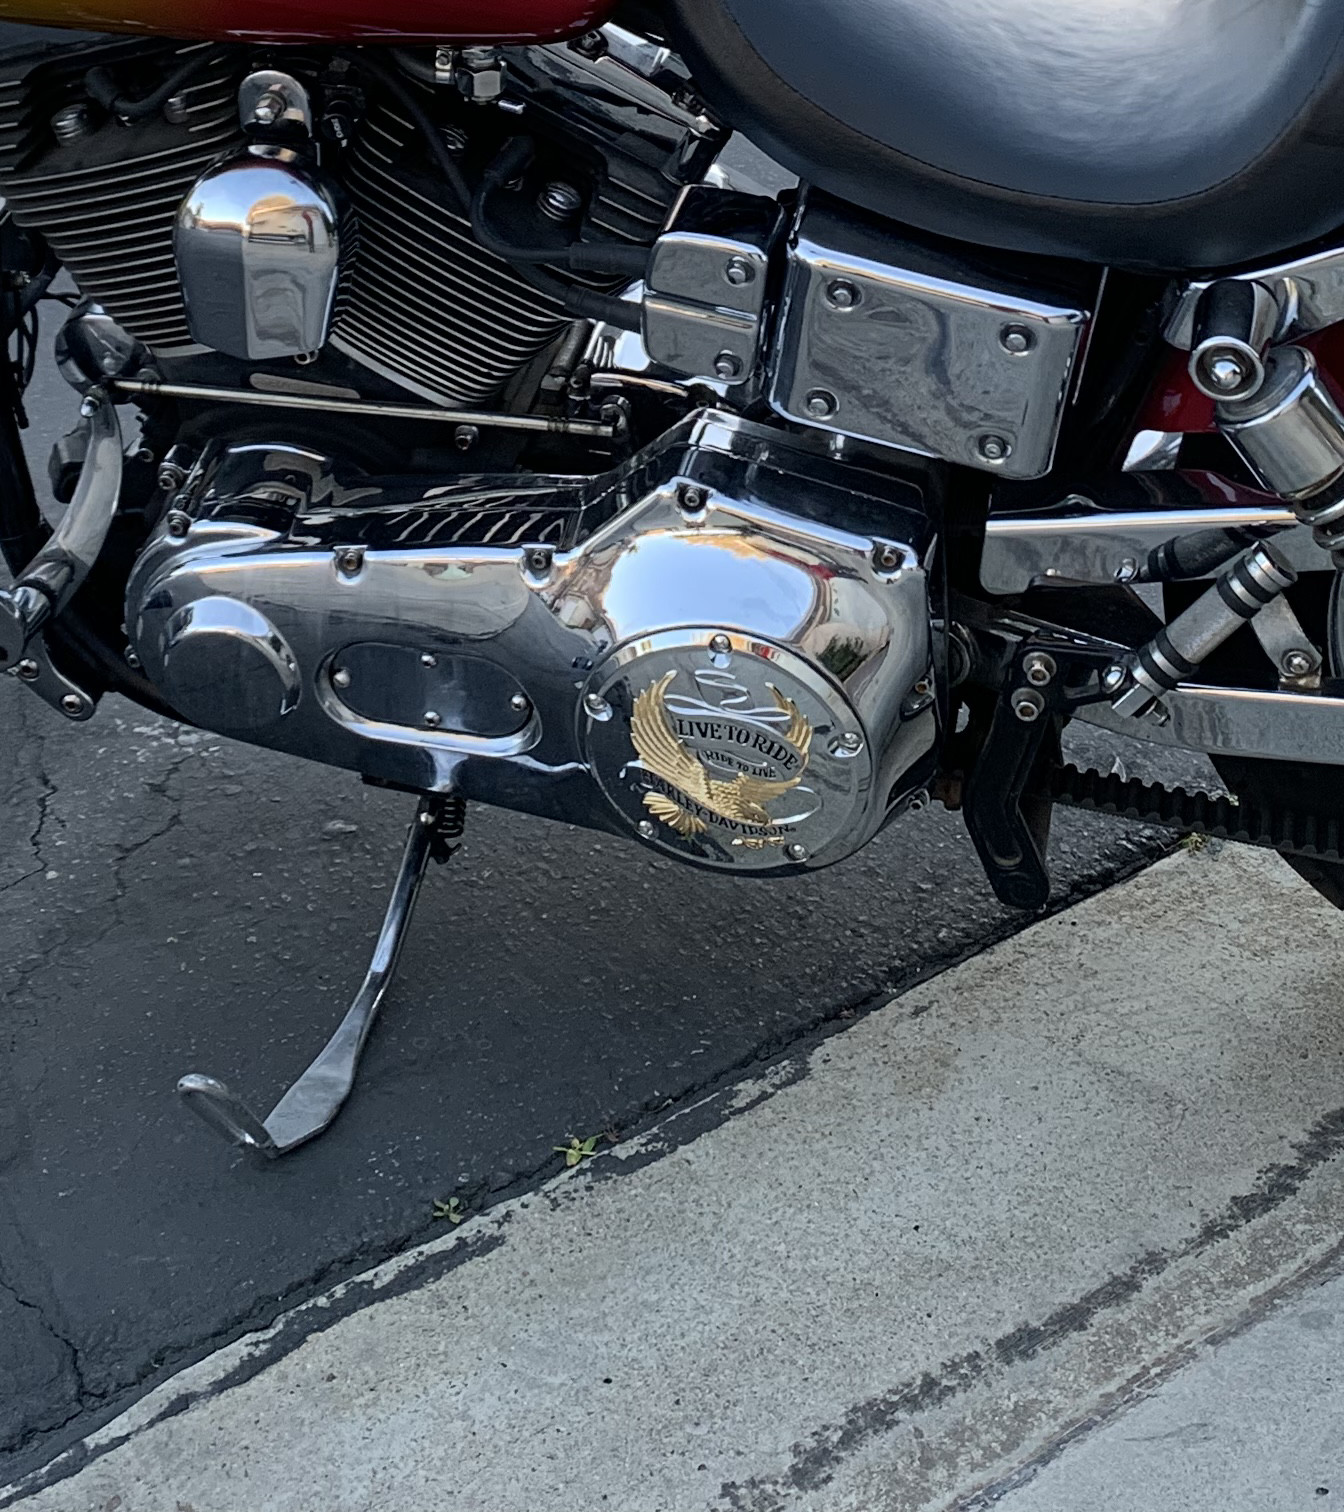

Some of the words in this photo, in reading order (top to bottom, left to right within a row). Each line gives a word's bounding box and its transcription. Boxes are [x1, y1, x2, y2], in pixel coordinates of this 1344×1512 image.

[677, 719, 722, 741] LIVE
[724, 725, 751, 744] TO
[752, 733, 798, 770] RIDE
[703, 750, 734, 767] RIDE
[737, 761, 749, 772] TO
[752, 767, 776, 778] LIVE
